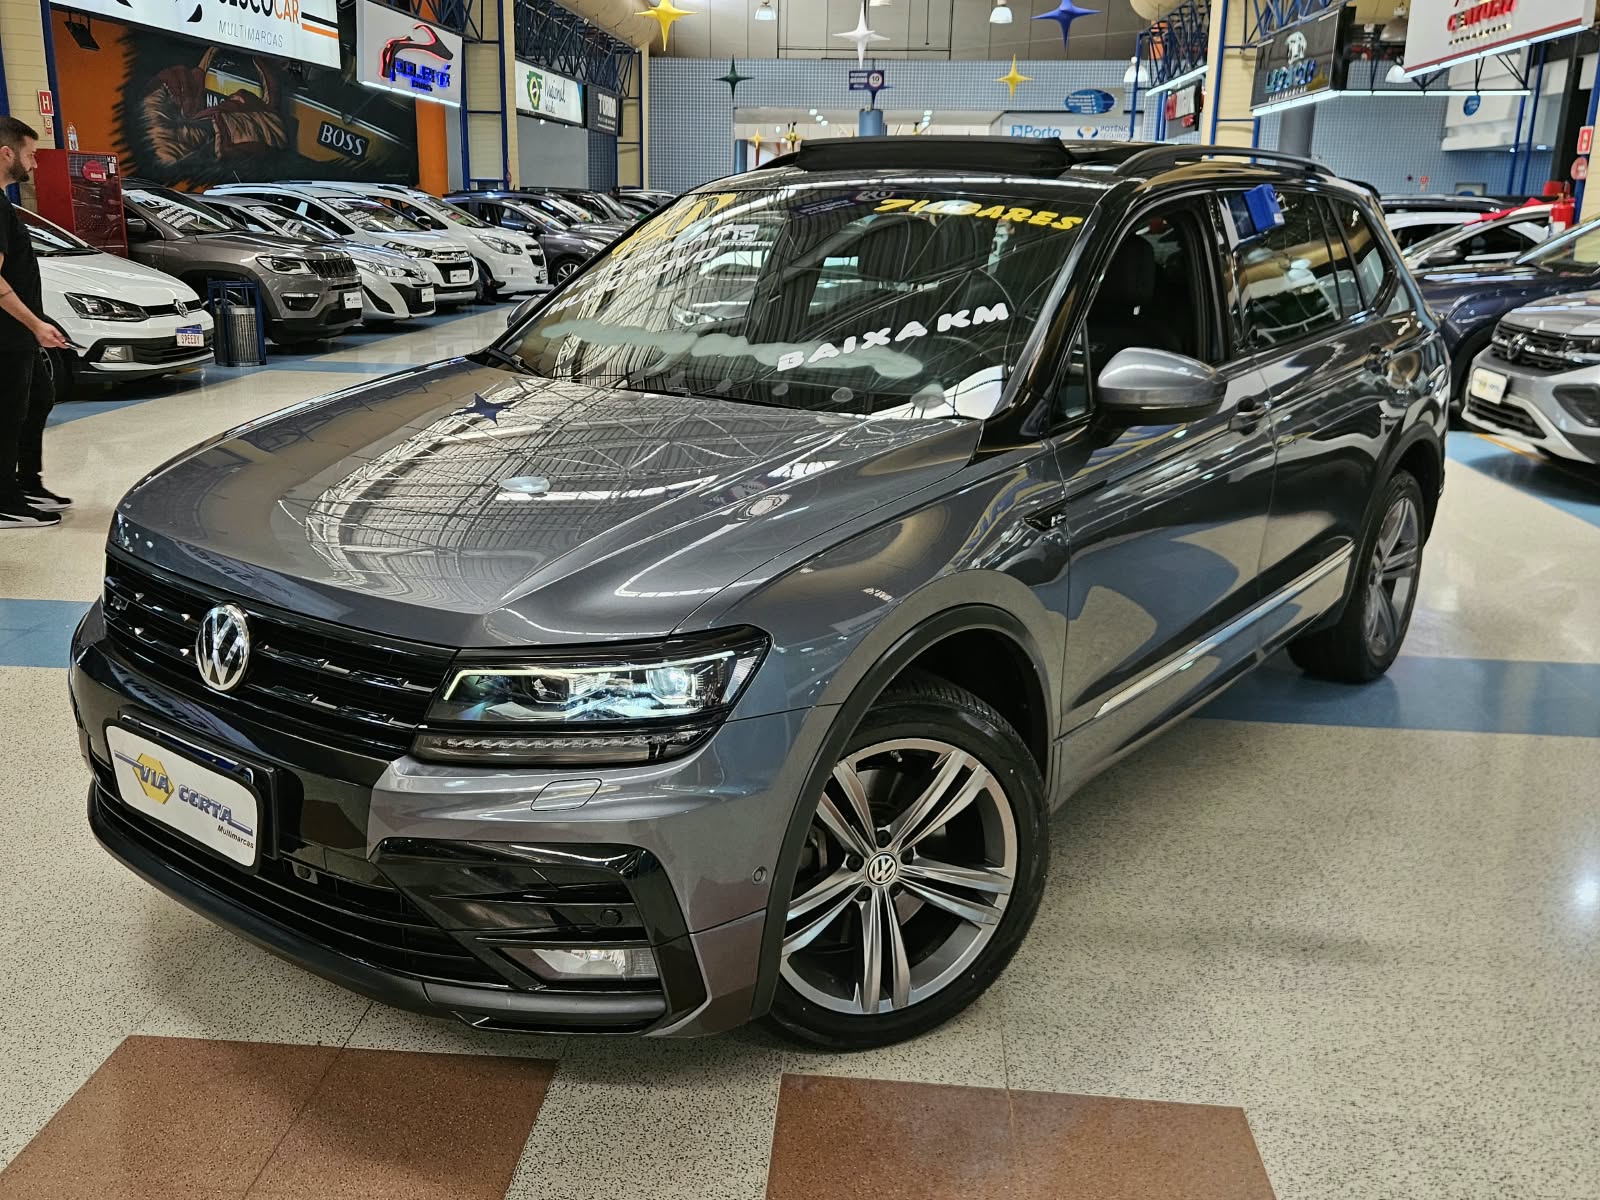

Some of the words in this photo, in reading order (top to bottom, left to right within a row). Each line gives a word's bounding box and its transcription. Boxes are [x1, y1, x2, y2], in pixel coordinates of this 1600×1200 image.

[218, 20, 284, 48] MULTIMARCAS
[321, 124, 366, 156] BOSS
[1024, 125, 1061, 138] Porto
[908, 199, 1085, 230] LUGARES
[634, 246, 720, 284] NOVO
[777, 320, 928, 371] BAIXA
[937, 302, 1010, 333] KM
[140, 764, 170, 794] VIA
[178, 784, 233, 823] CERTA
[217, 824, 254, 849] Multimarcas
